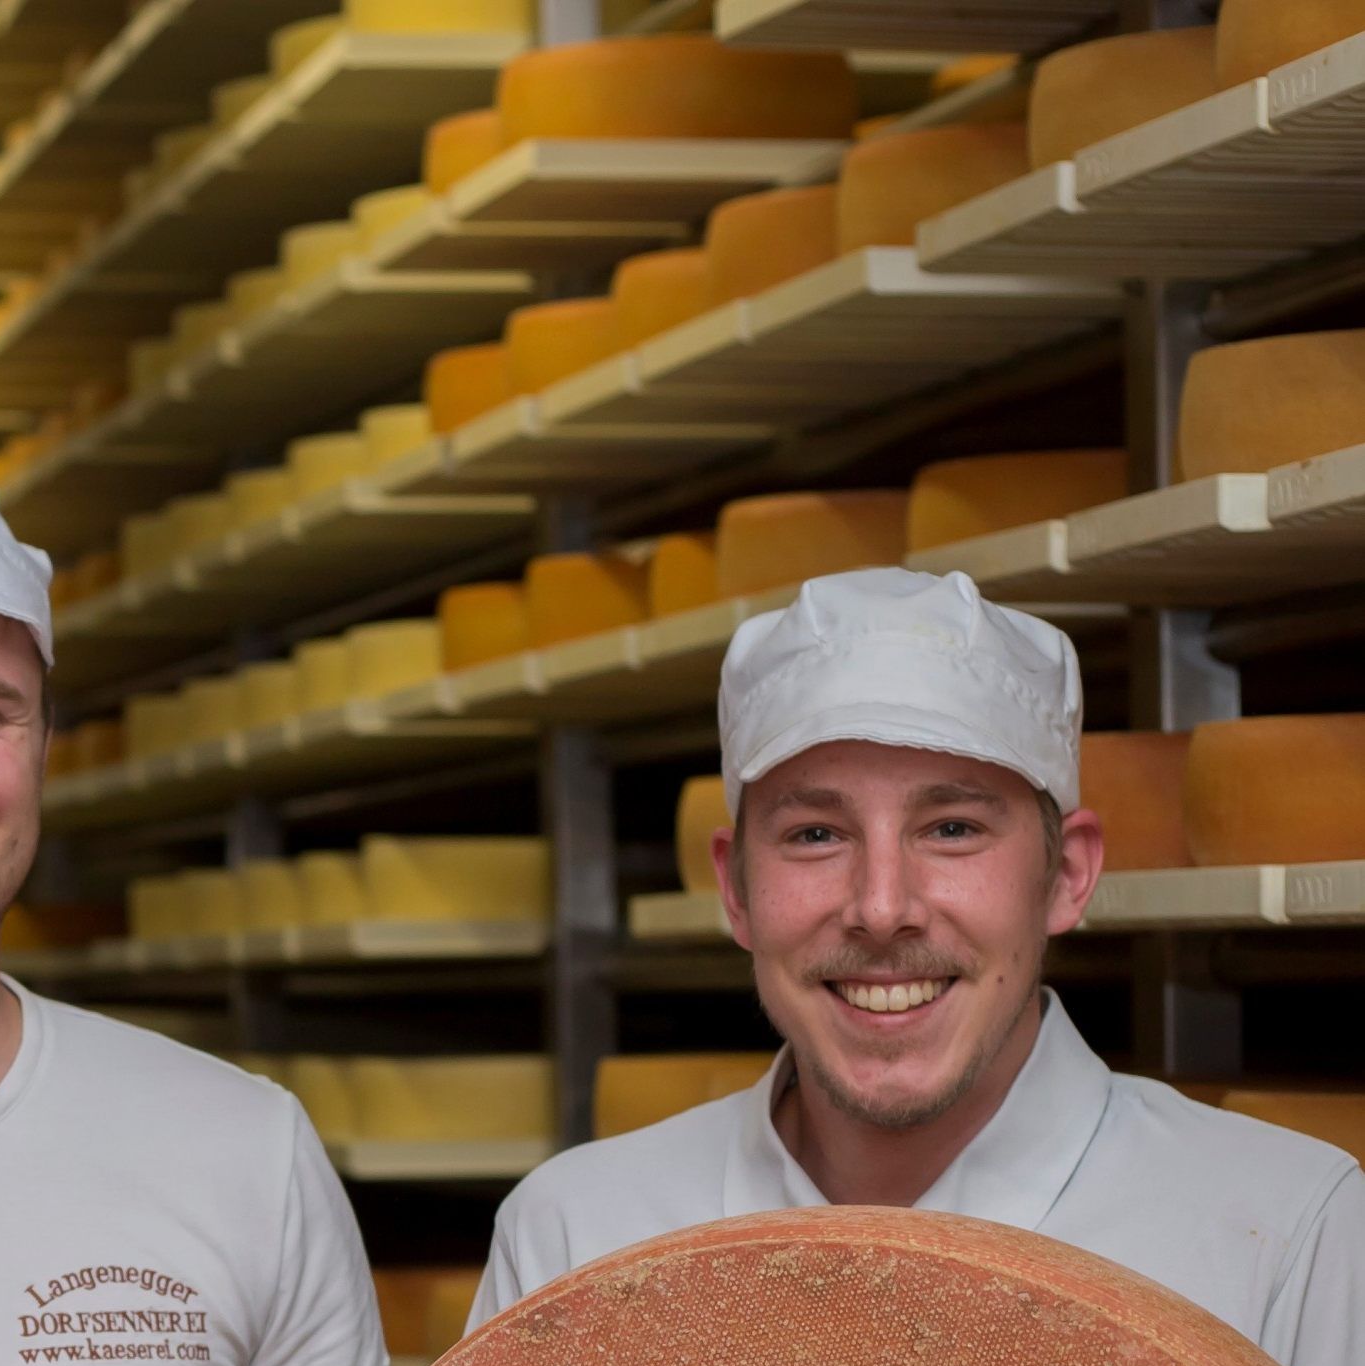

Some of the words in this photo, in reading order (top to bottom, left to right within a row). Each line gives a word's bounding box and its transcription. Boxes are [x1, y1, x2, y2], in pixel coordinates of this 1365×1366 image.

[25, 1265, 198, 1308] Langenegger
[18, 1310, 207, 1337] DORFSENNEREI
[19, 1338, 210, 1364] www.kaeserei.com
